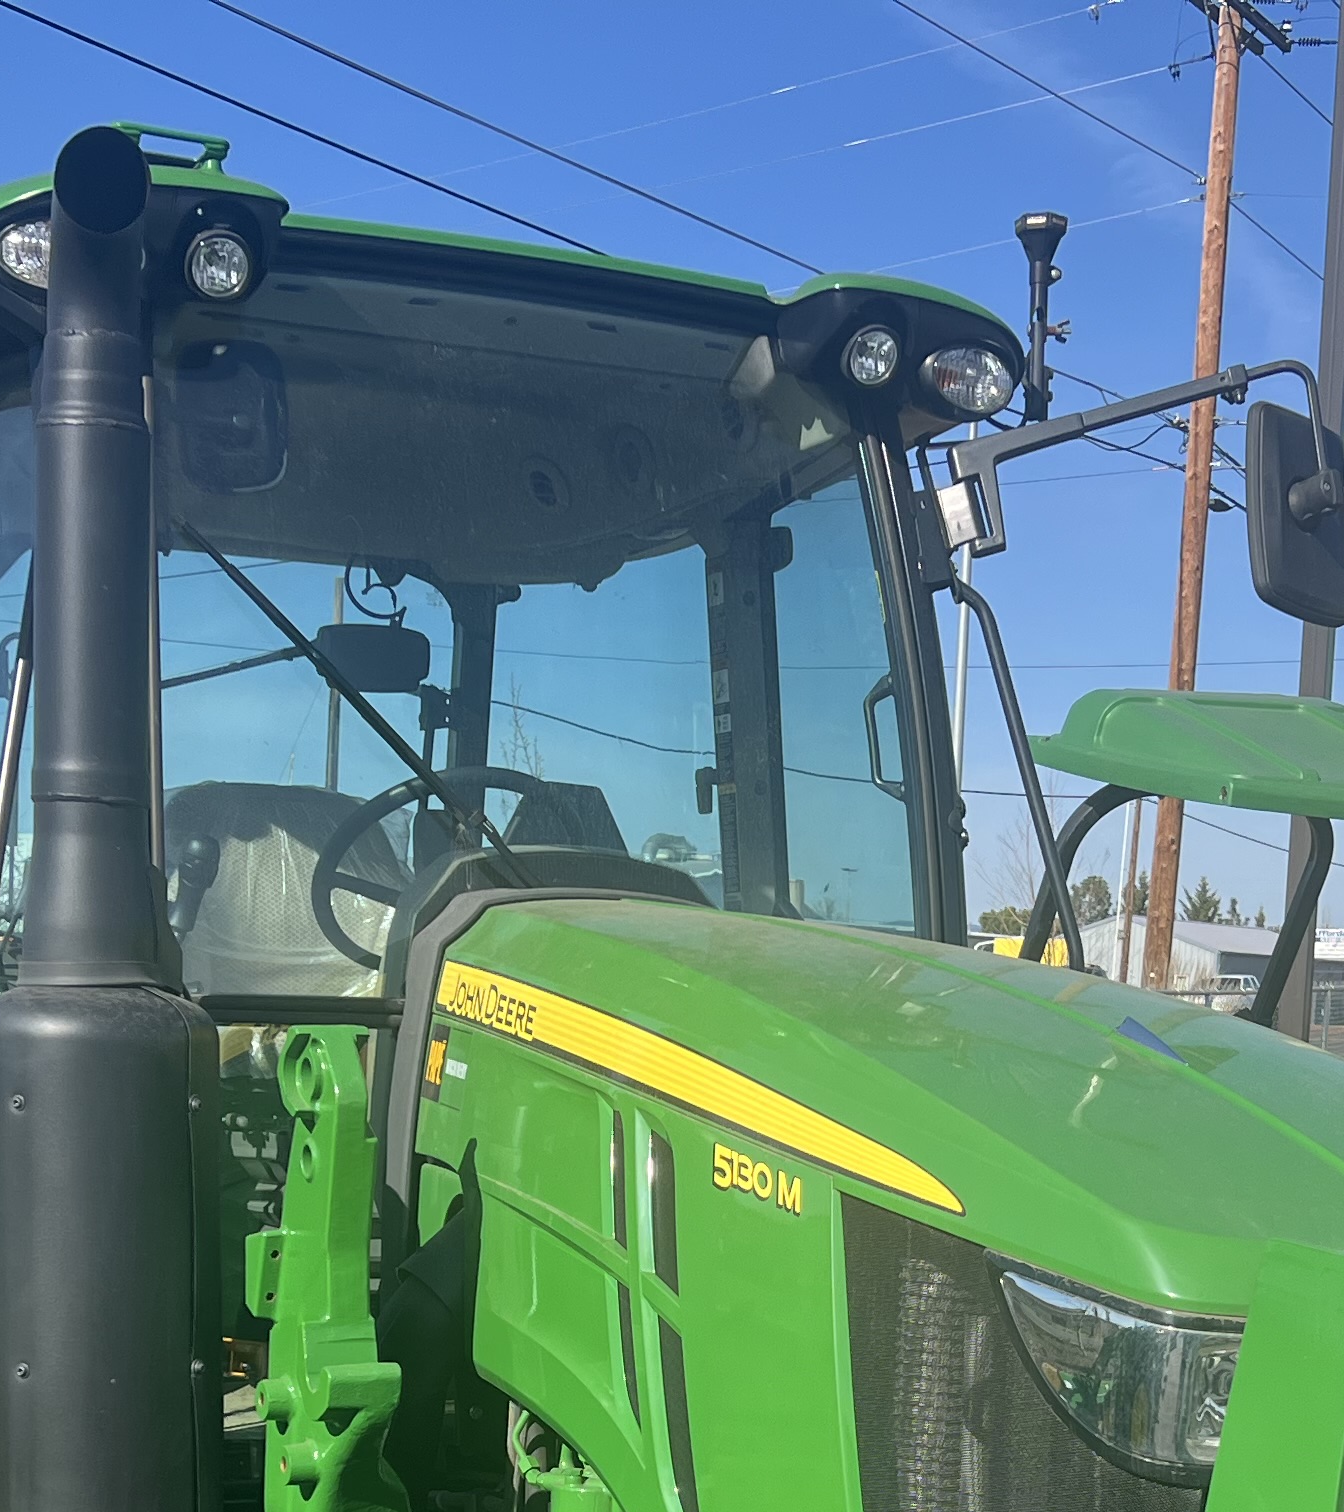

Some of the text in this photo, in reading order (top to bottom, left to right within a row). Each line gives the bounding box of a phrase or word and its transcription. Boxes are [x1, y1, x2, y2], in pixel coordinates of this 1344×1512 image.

[448, 972, 538, 1039] JOHN DEERE
[713, 1142, 801, 1217] 5130 M
